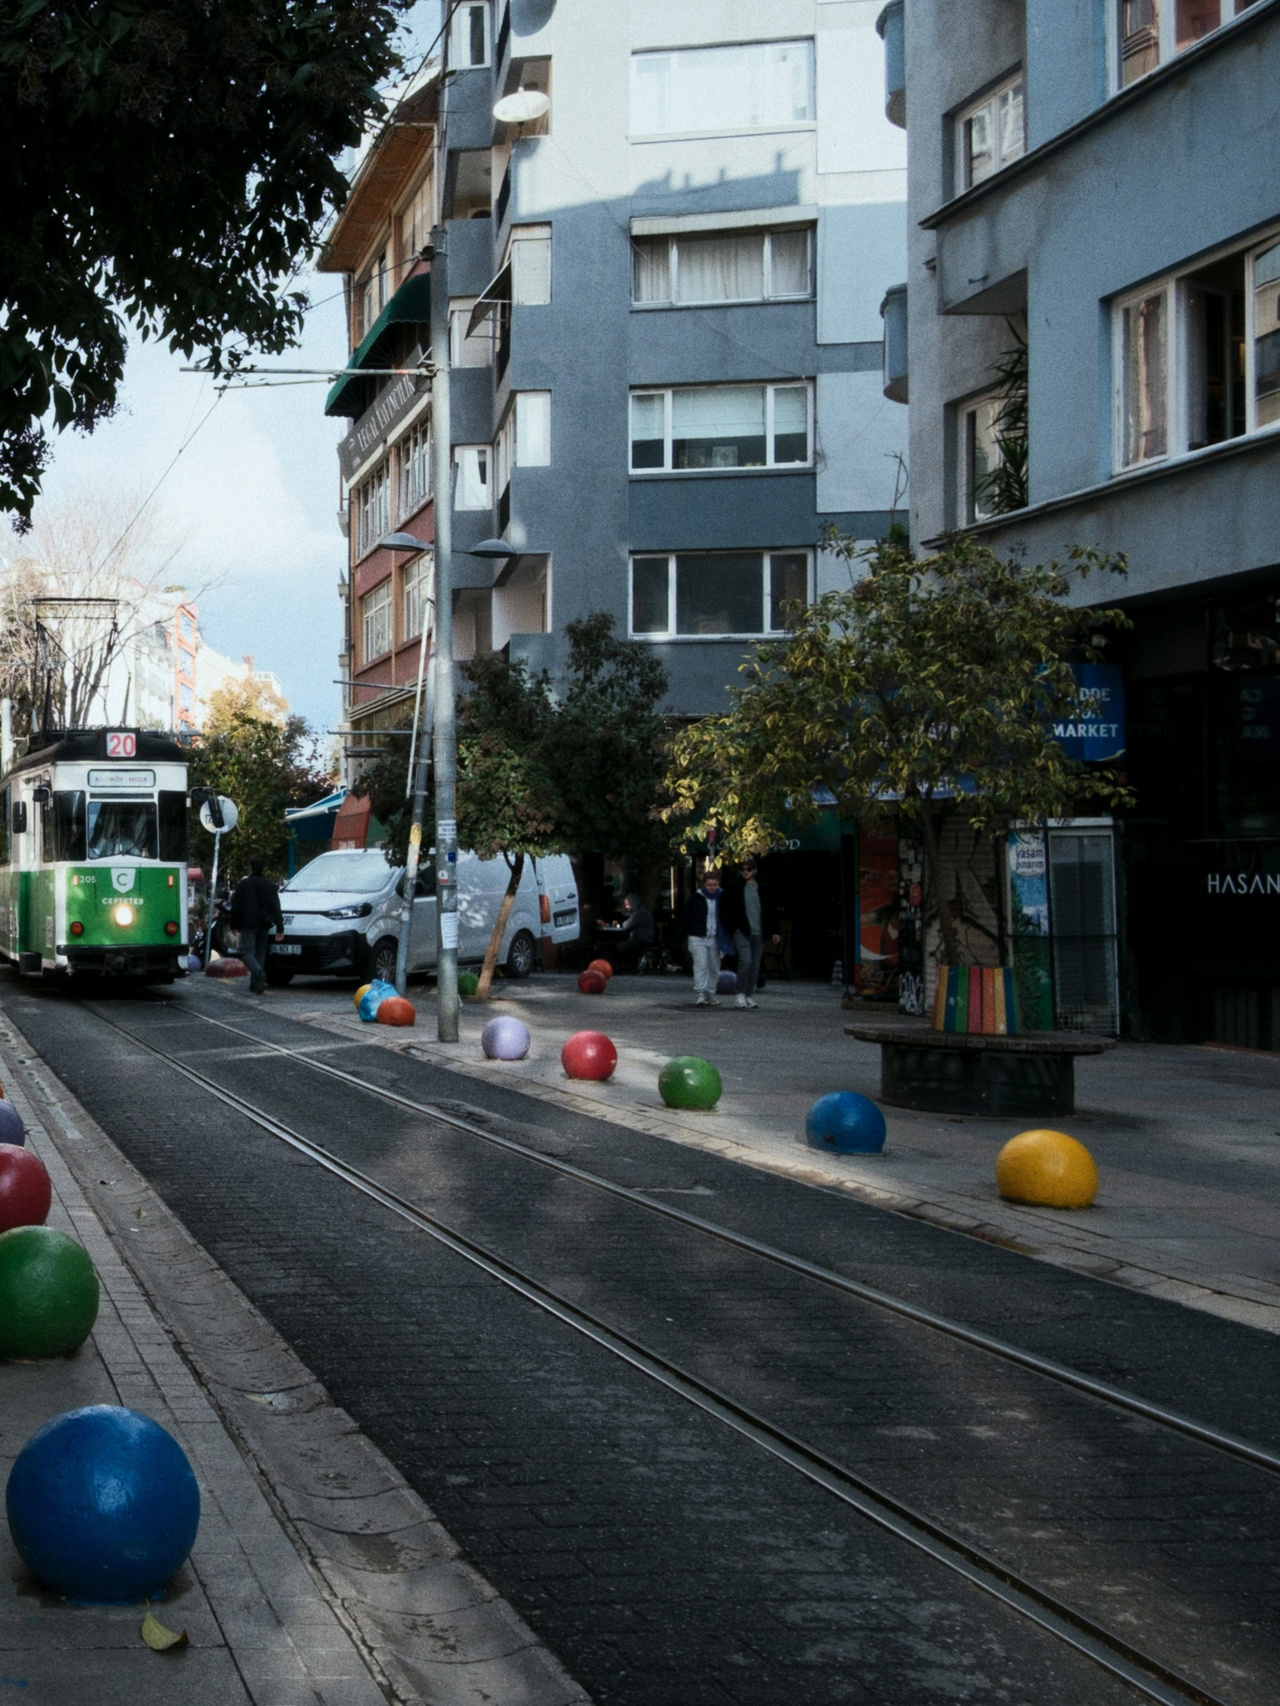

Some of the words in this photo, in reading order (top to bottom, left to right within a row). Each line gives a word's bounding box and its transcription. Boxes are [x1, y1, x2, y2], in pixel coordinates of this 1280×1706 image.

[357, 416, 380, 452] LEGAL
[1052, 723, 1119, 738] MARKET
[109, 733, 136, 756] 20
[80, 875, 97, 884] 205
[116, 873, 128, 886] C
[1207, 873, 1280, 894] HASAN
[101, 897, 144, 905] CEPTETEB
